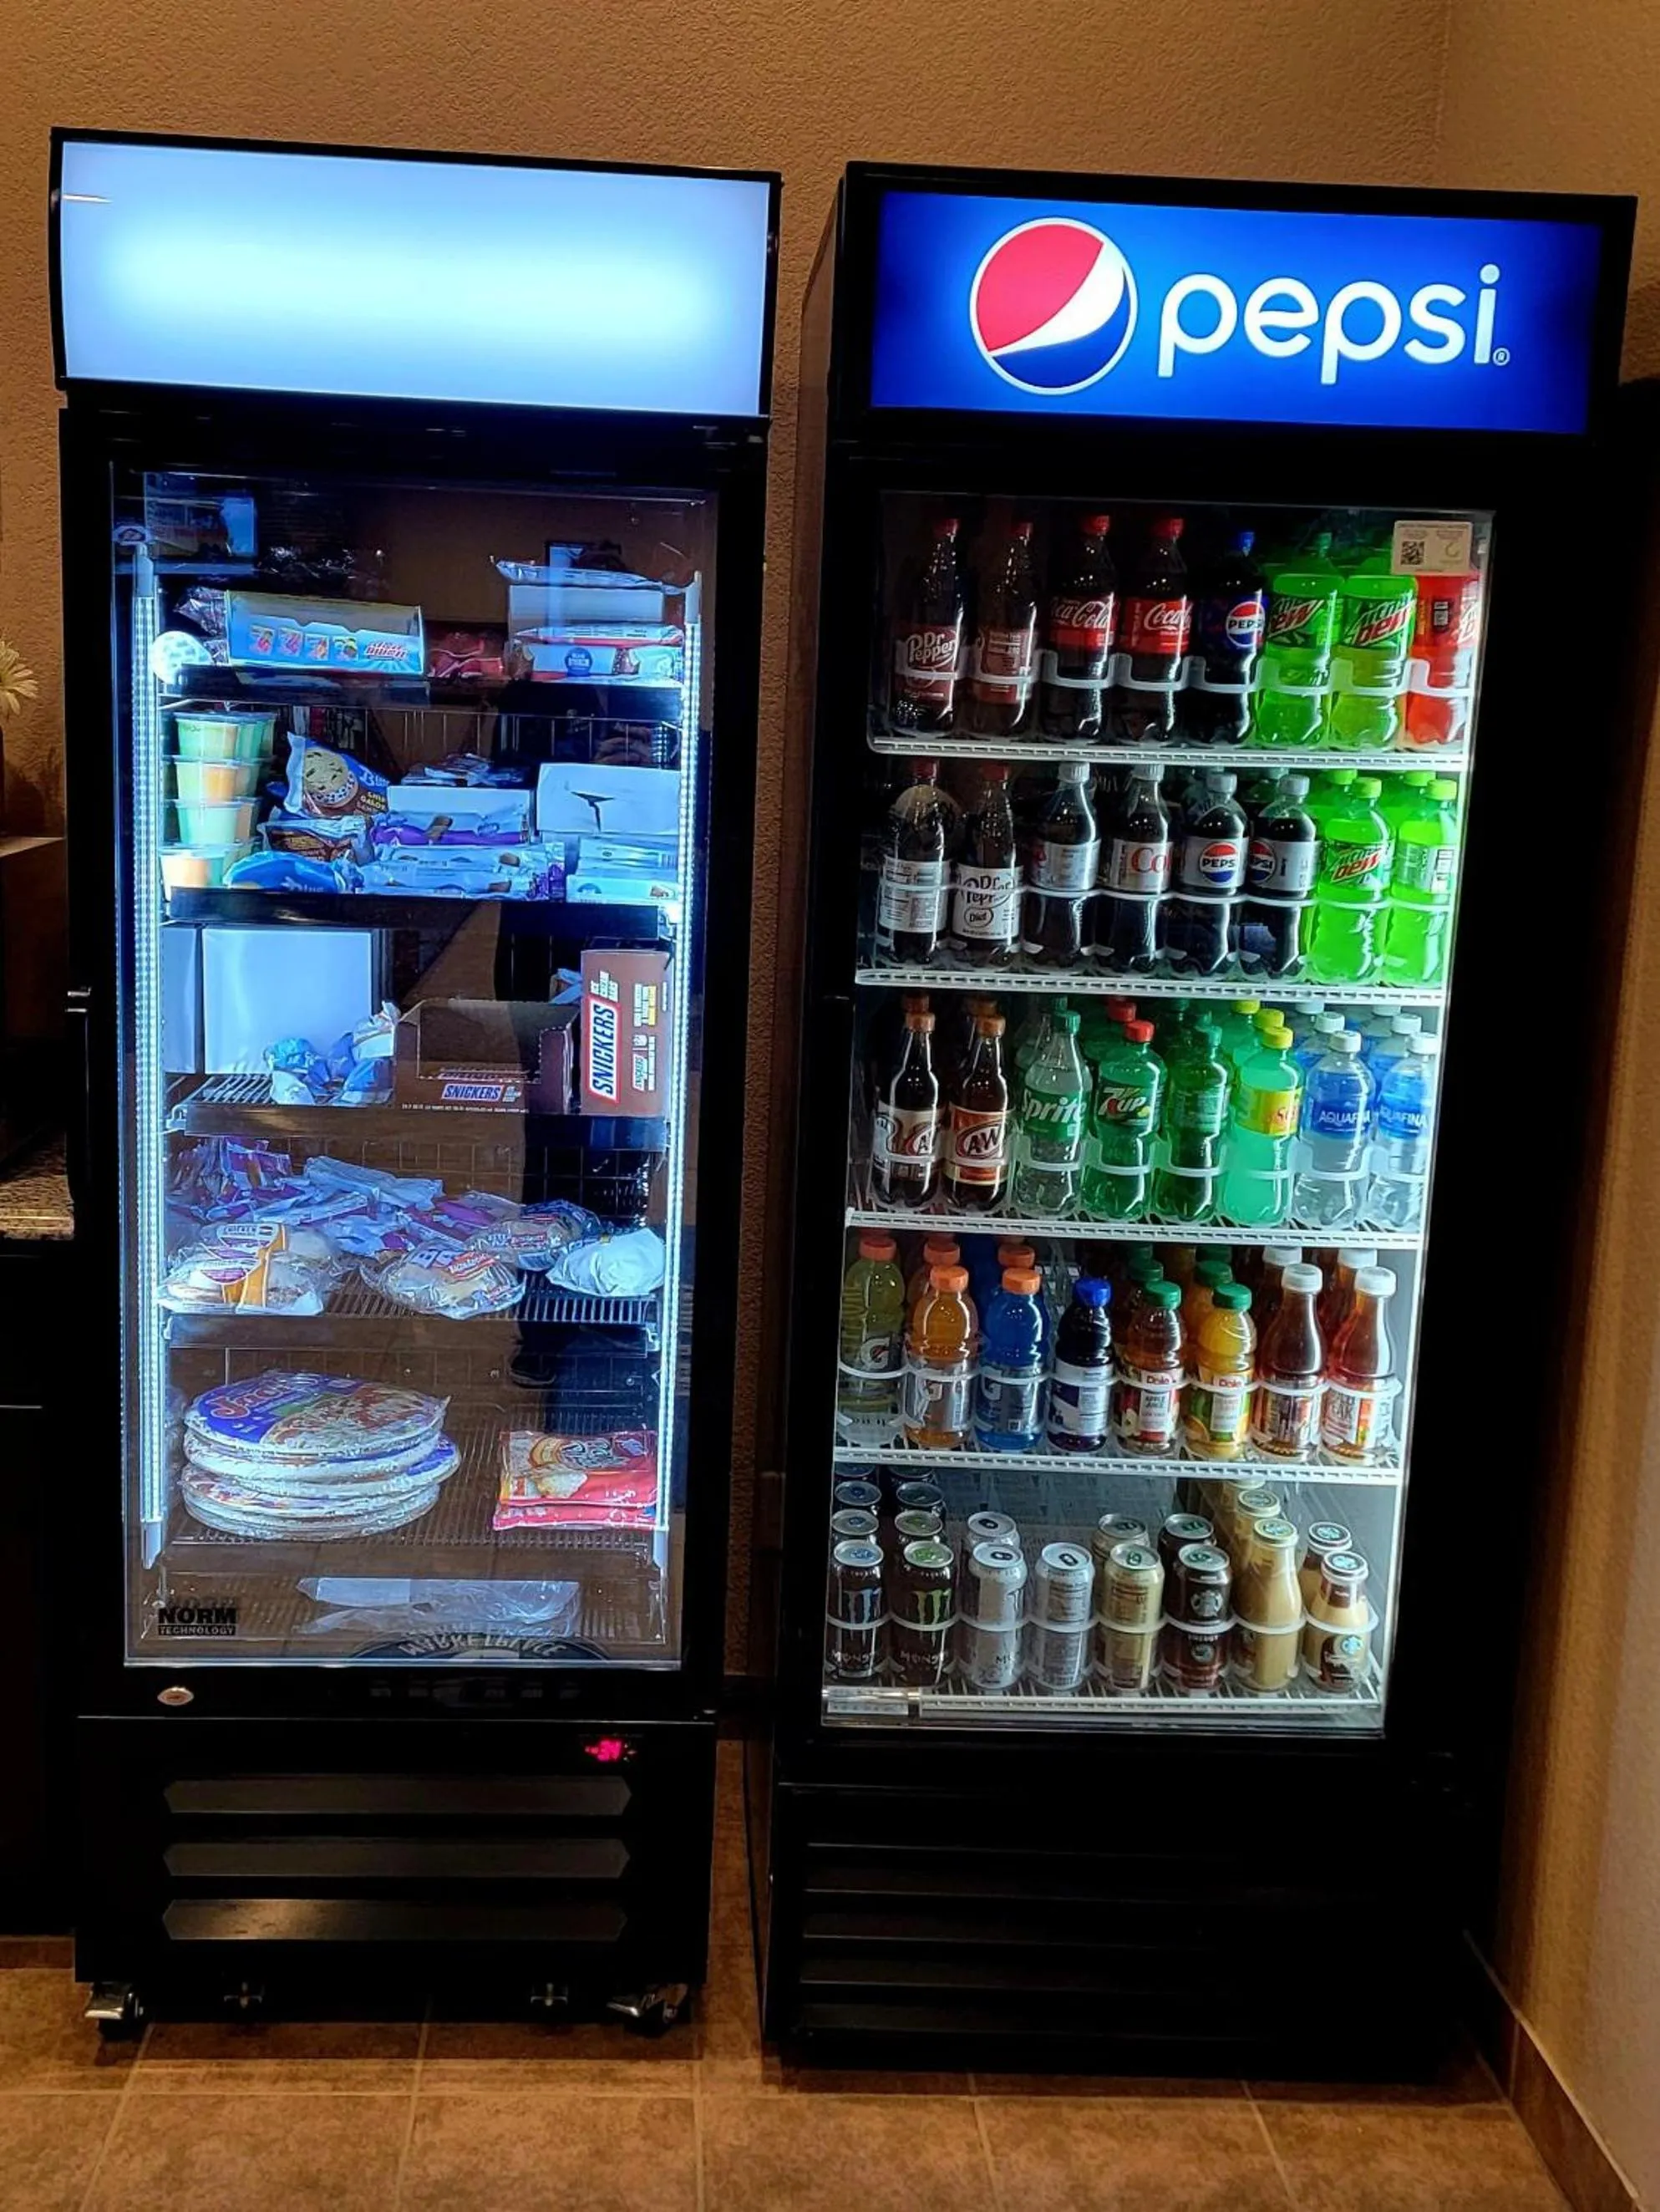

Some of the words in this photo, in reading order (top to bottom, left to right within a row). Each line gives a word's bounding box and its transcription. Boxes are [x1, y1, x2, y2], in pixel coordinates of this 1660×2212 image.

[1157, 263, 1501, 385] pepsi
[906, 633, 957, 664] Pepper
[923, 632, 945, 649] Dr
[1201, 858, 1236, 869] PEPS
[591, 1004, 616, 1095] SNICKERS
[444, 1085, 500, 1100] SNICKERS
[159, 1608, 237, 1624] NORM
[159, 1625, 236, 1635] TECHNOLOGY
